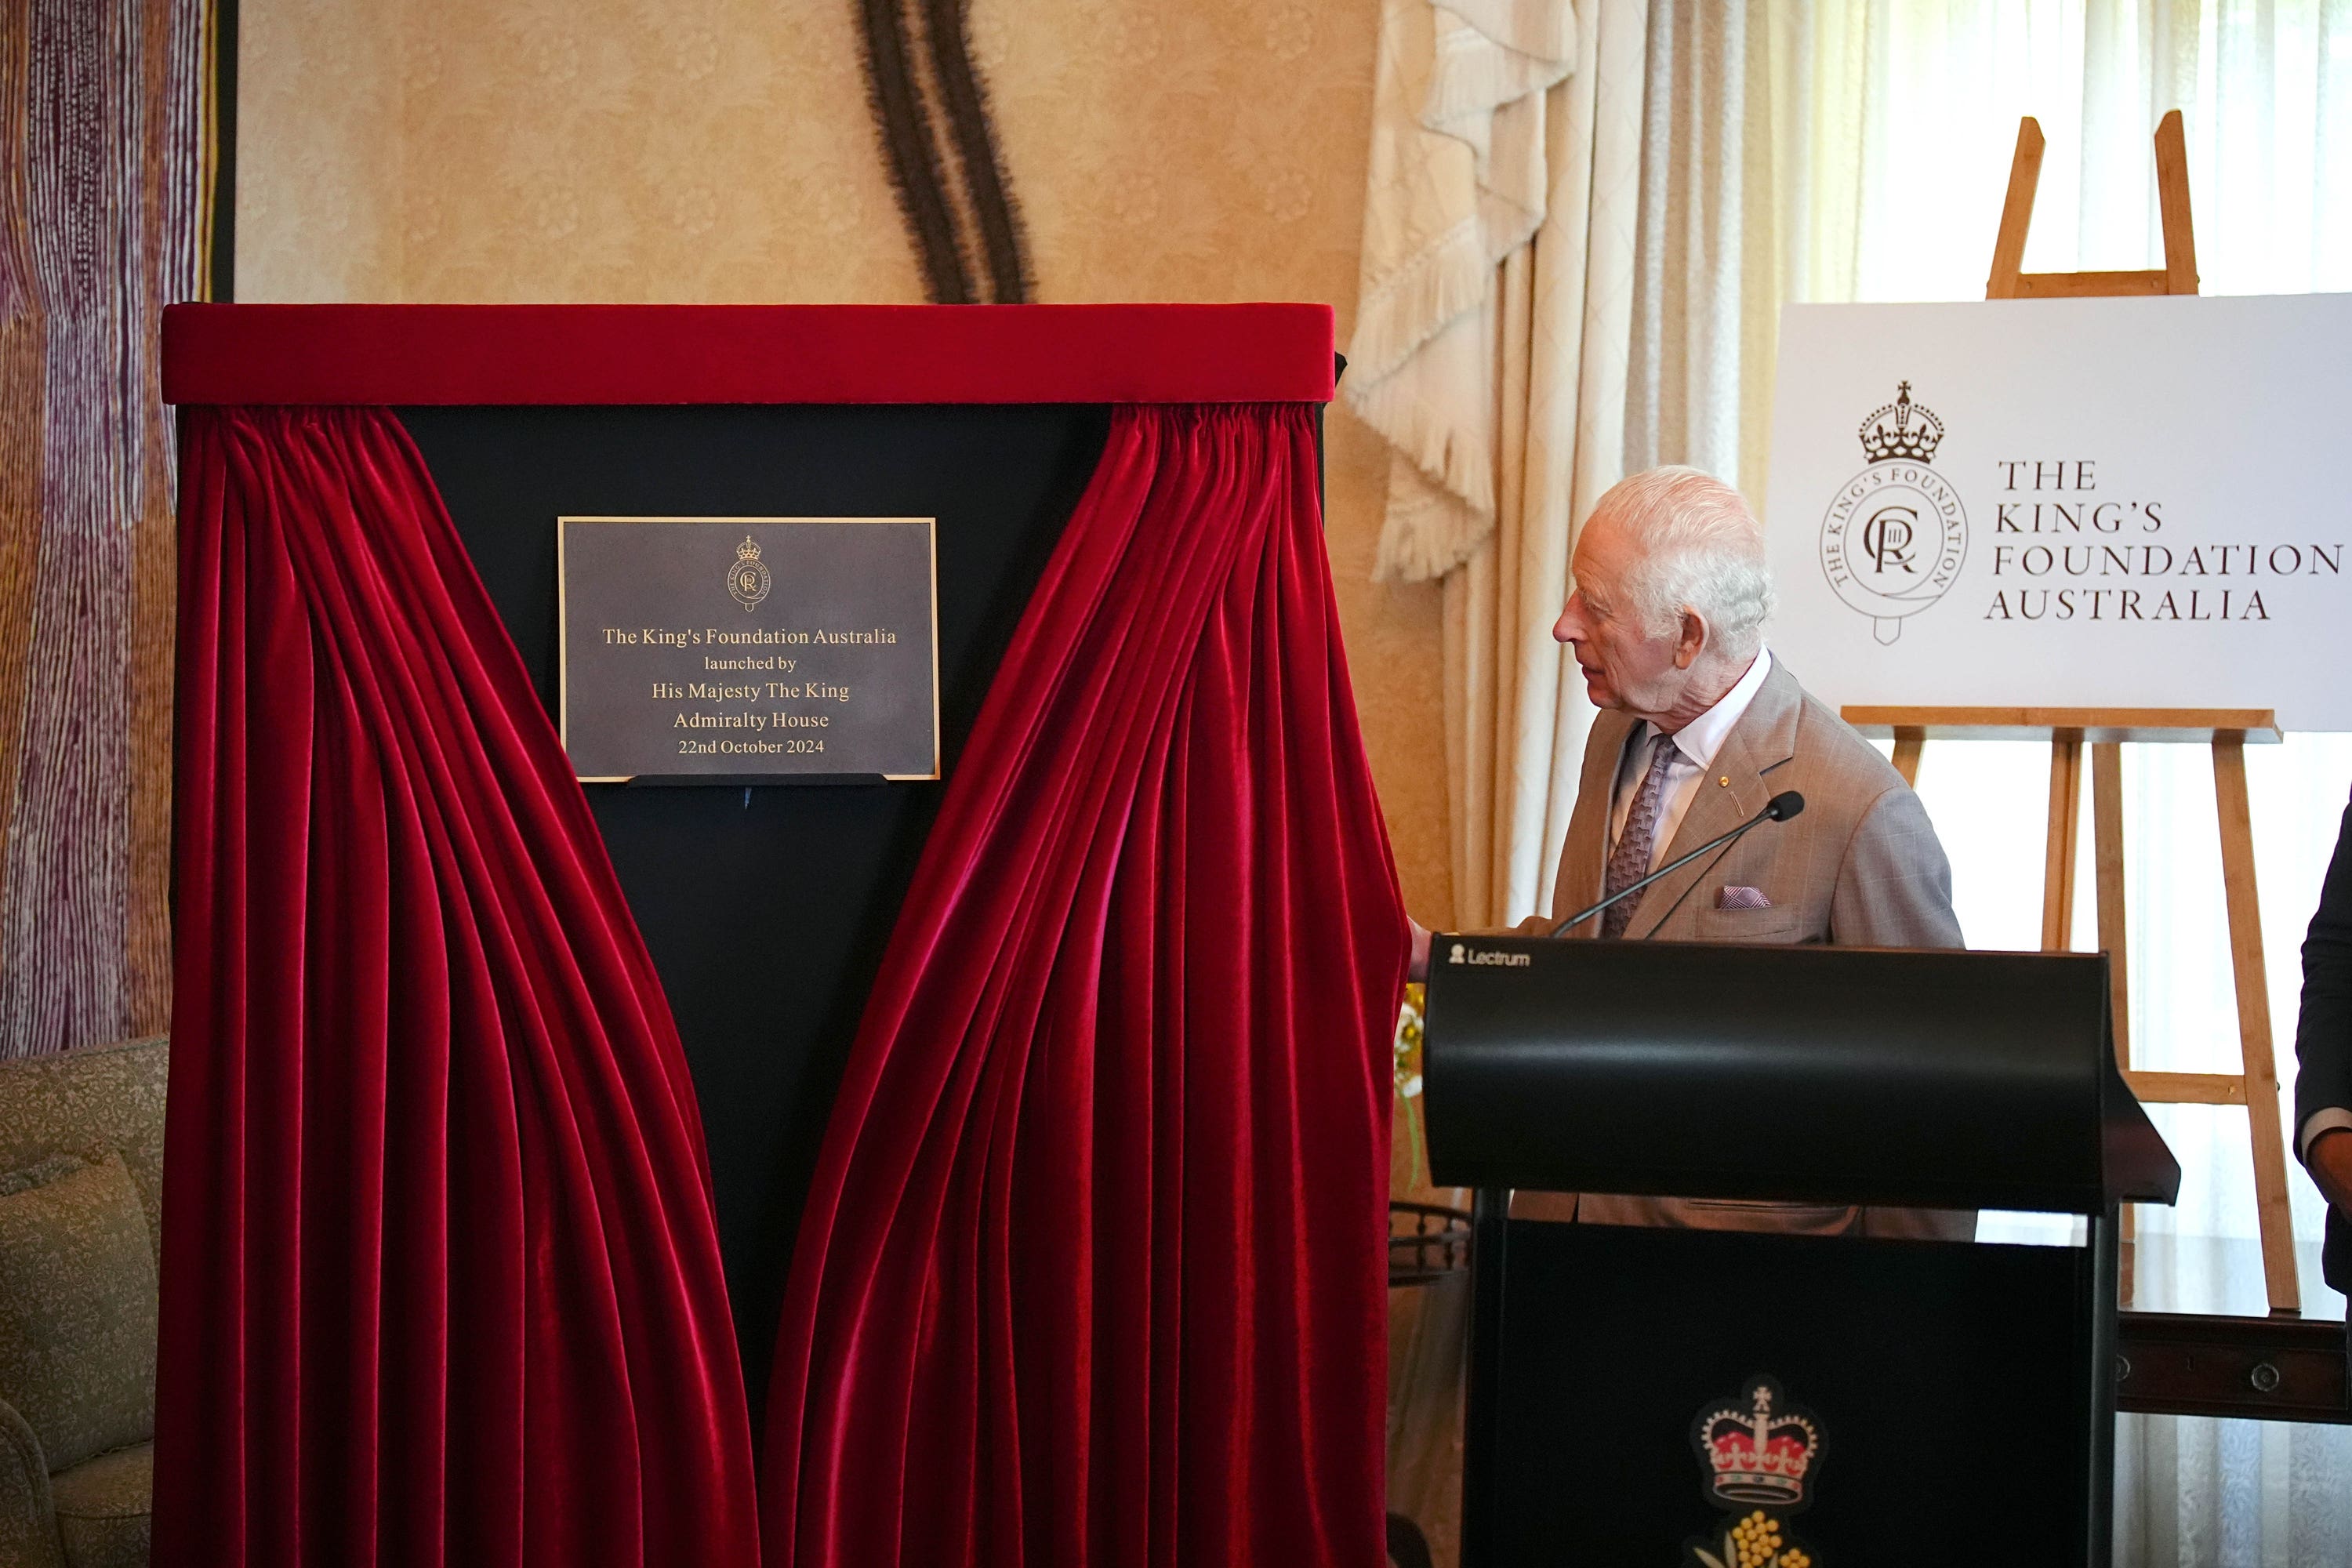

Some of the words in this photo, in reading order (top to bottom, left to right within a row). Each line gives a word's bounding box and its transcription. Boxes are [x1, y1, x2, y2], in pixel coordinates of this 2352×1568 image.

[1998, 460, 2096, 491] THE
[1827, 471, 1882, 536] KING'S
[1995, 501, 2162, 533] KING’S
[1890, 467, 1962, 589] FOUNDATION
[1826, 543, 1849, 588] THE
[1993, 543, 2345, 576] FOUNDATION
[1983, 589, 2272, 621] AUSTRALIA
[602, 628, 637, 644] The
[642, 628, 701, 648] King's
[706, 628, 809, 644] Foundation
[812, 628, 897, 644] Australia
[705, 655, 774, 670] launched
[778, 656, 797, 673] by
[652, 682, 683, 699] His
[688, 682, 761, 702] Majesty
[765, 682, 800, 699] The
[805, 682, 850, 702] King
[673, 711, 768, 731] Admiralty
[771, 712, 829, 728] House
[678, 739, 717, 754] 22nd
[720, 739, 783, 754] October
[786, 739, 825, 753] 2024
[1468, 949, 1530, 967] Lectrum
